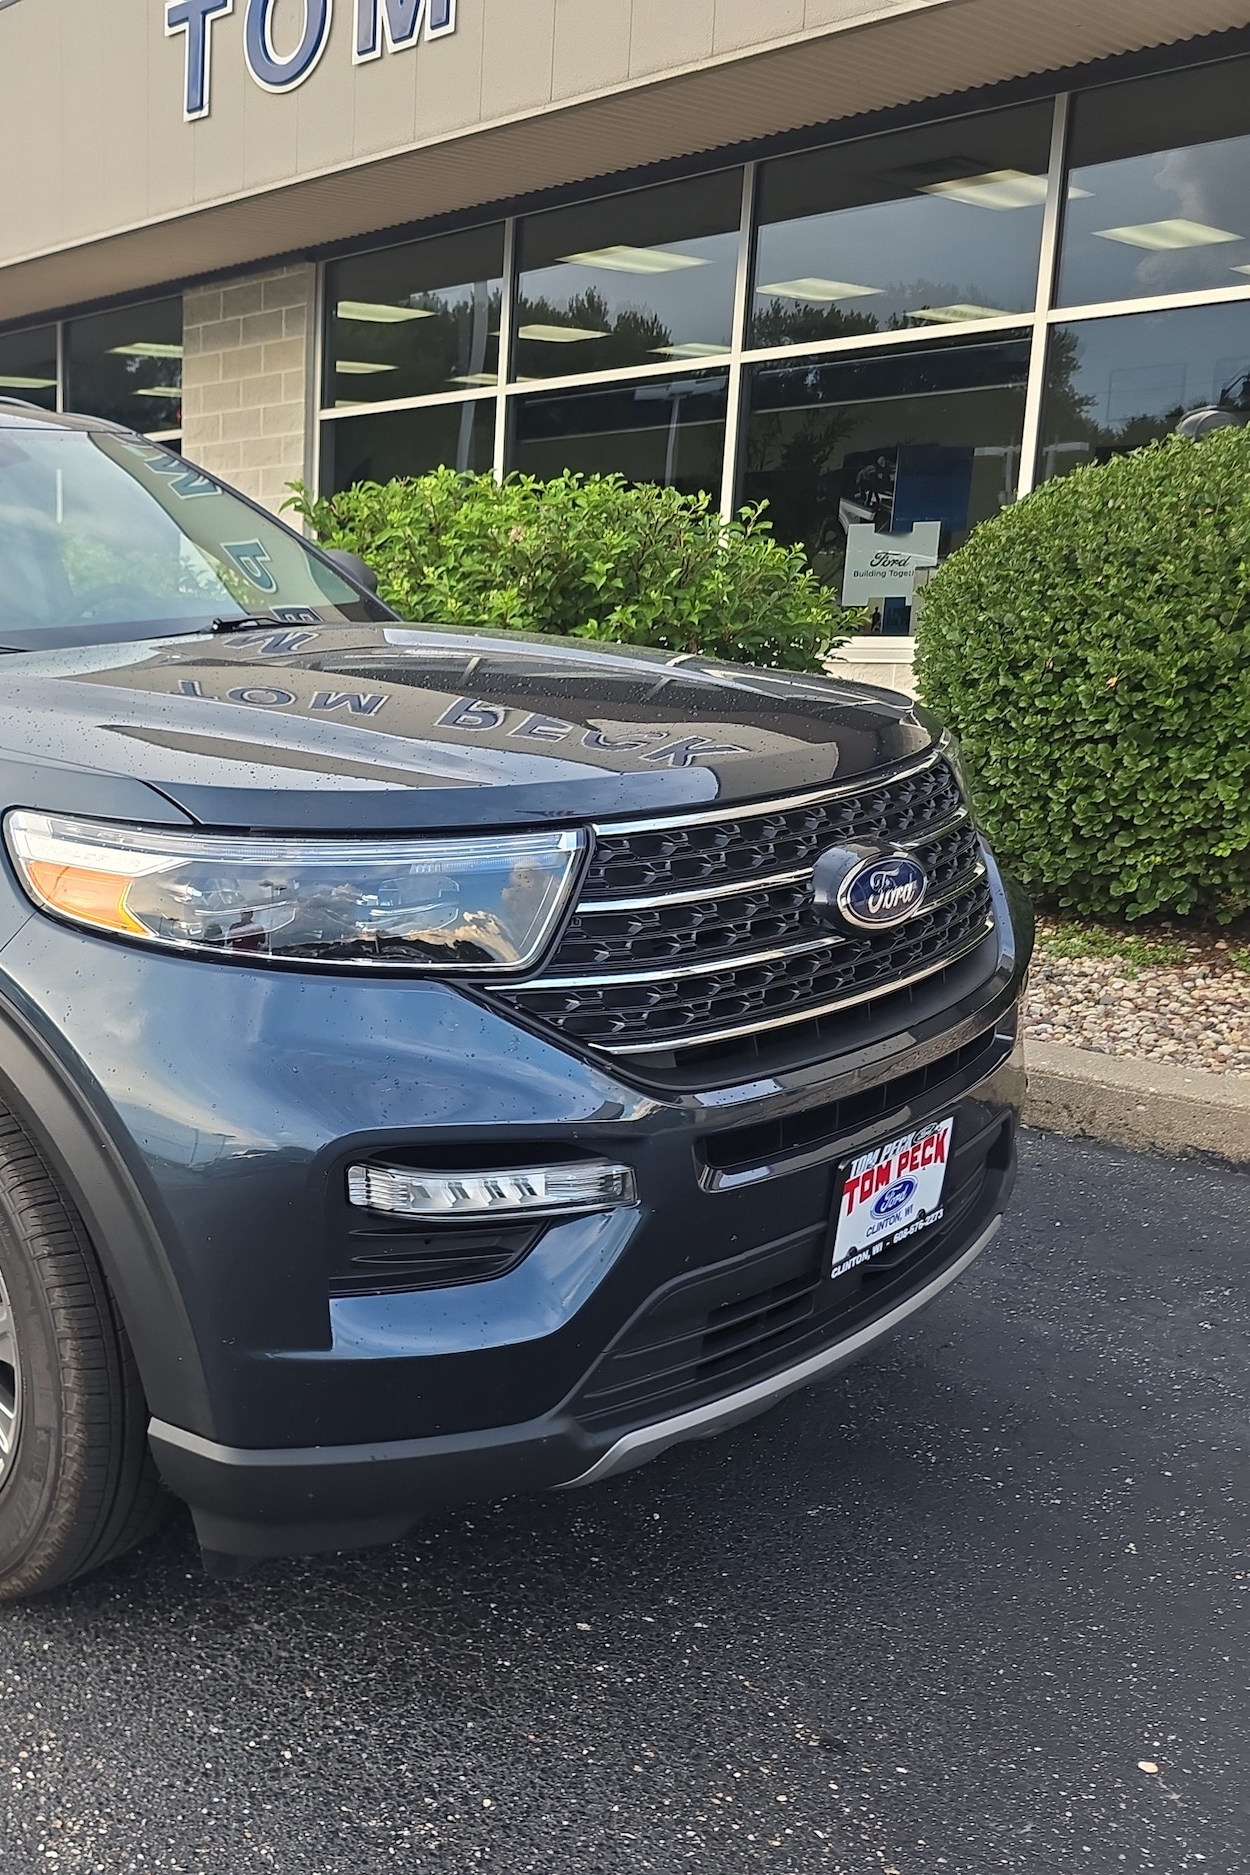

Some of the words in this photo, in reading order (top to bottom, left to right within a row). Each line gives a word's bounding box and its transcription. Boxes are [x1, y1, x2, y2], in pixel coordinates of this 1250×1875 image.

[853, 570, 887, 578] Building
[870, 551, 911, 567] Ford
[868, 867, 917, 914] Ford
[843, 1159, 892, 1217] TOM
[897, 1127, 949, 1178] PECK
[880, 1183, 910, 1212] Ford
[866, 1212, 902, 1238] CLINTON,
[904, 1204, 914, 1217] WI
[830, 1249, 870, 1279] CLINTON,
[872, 1241, 884, 1256] WI
